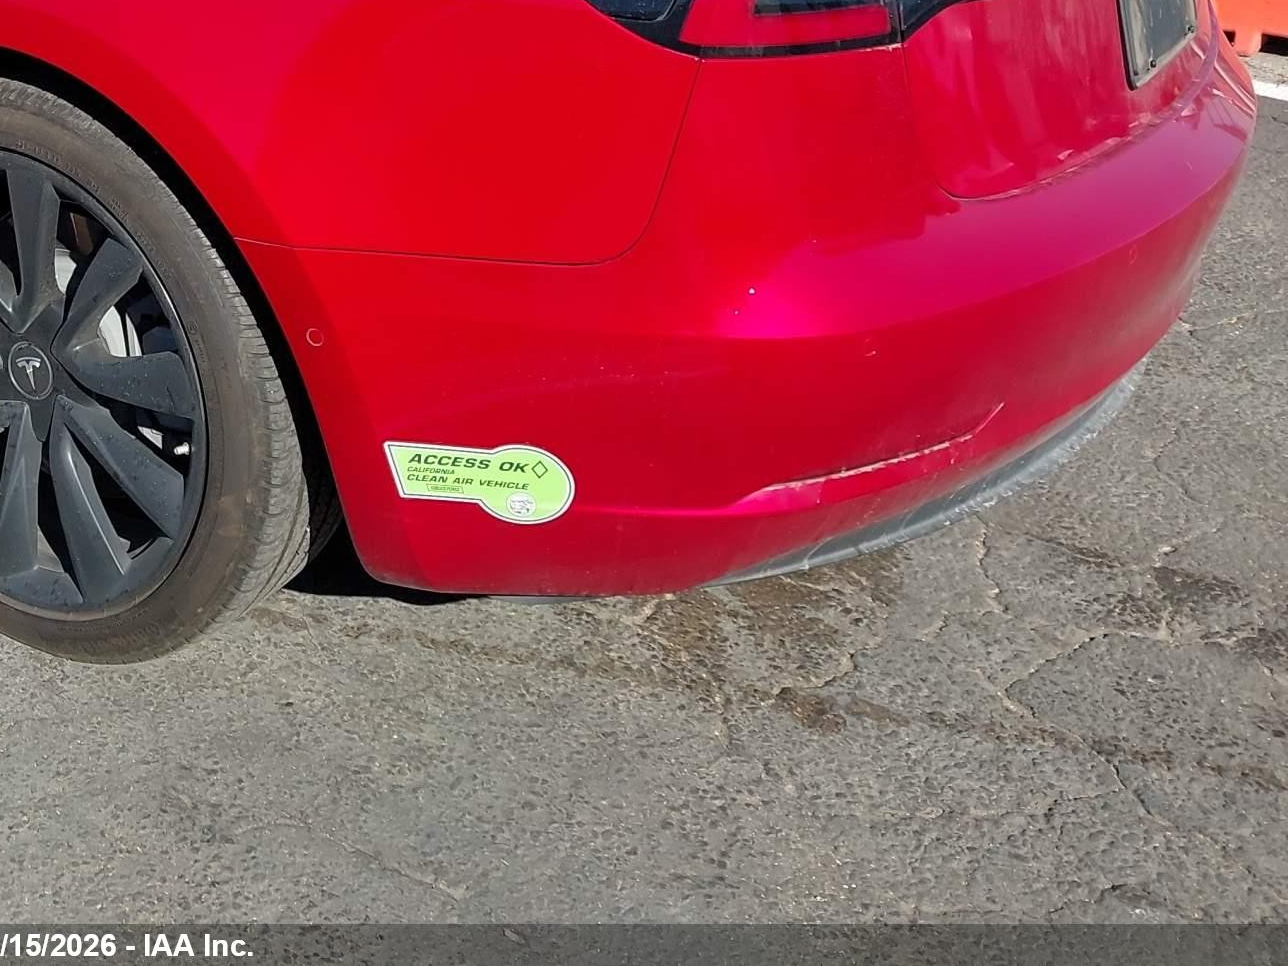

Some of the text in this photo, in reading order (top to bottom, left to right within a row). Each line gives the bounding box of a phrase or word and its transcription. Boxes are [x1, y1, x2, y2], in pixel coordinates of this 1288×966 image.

[407, 466, 455, 475] CALIFORNIA
[408, 453, 530, 474] ACCESS OK
[407, 474, 530, 491] CLEAN AIR VEHICLE
